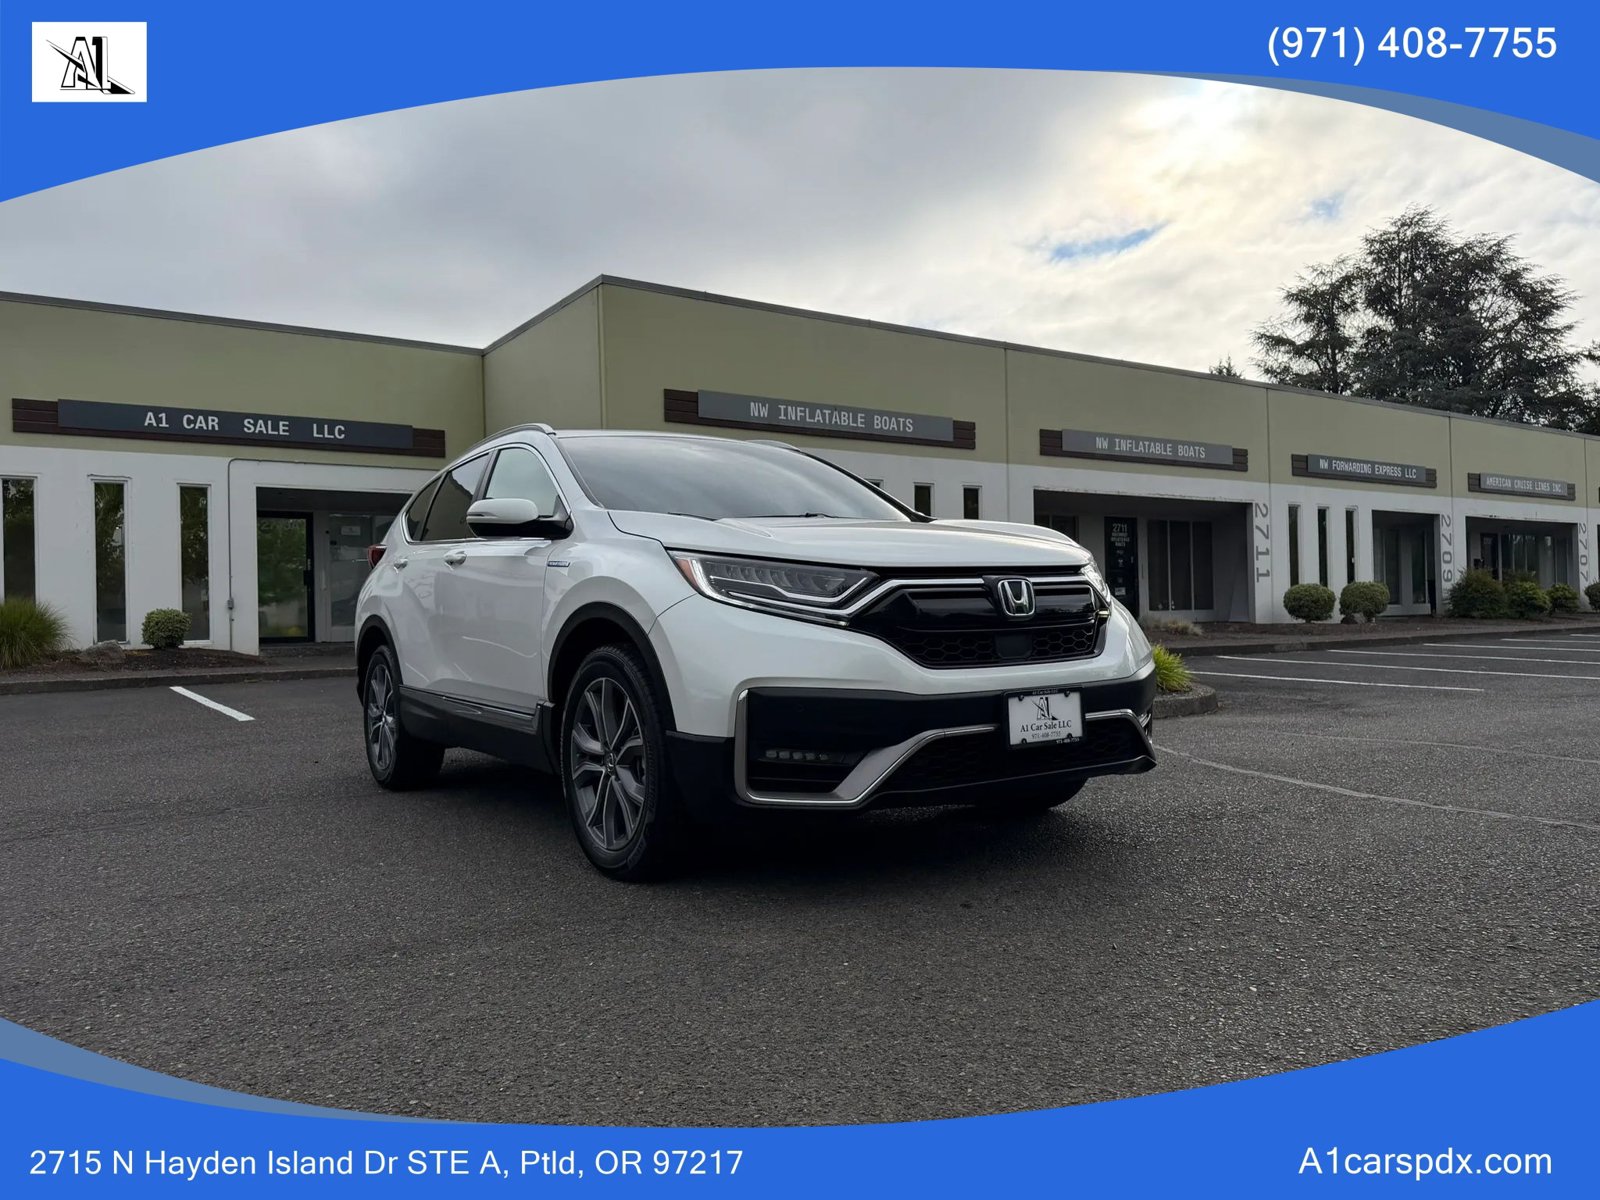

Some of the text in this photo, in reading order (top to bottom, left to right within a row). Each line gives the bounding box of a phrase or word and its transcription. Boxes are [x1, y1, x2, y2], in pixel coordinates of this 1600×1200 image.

[144, 411, 346, 440] A1 CAR SALE LLC
[750, 401, 914, 433] NW INFLATABLE BOATS
[1095, 436, 1206, 459] NW INFLATABLE BOATS
[1319, 458, 1417, 479] NW FORWARDING EXPRESS LLC
[1486, 476, 1512, 488] AMERICAN
[1514, 478, 1532, 490] CRUISE
[1535, 480, 1550, 492] LINES
[1254, 502, 1270, 583] 2711
[1441, 514, 1453, 583] 2709
[1578, 522, 1589, 582] 2707
[1020, 720, 1072, 733] A1 Car Sale LLC
